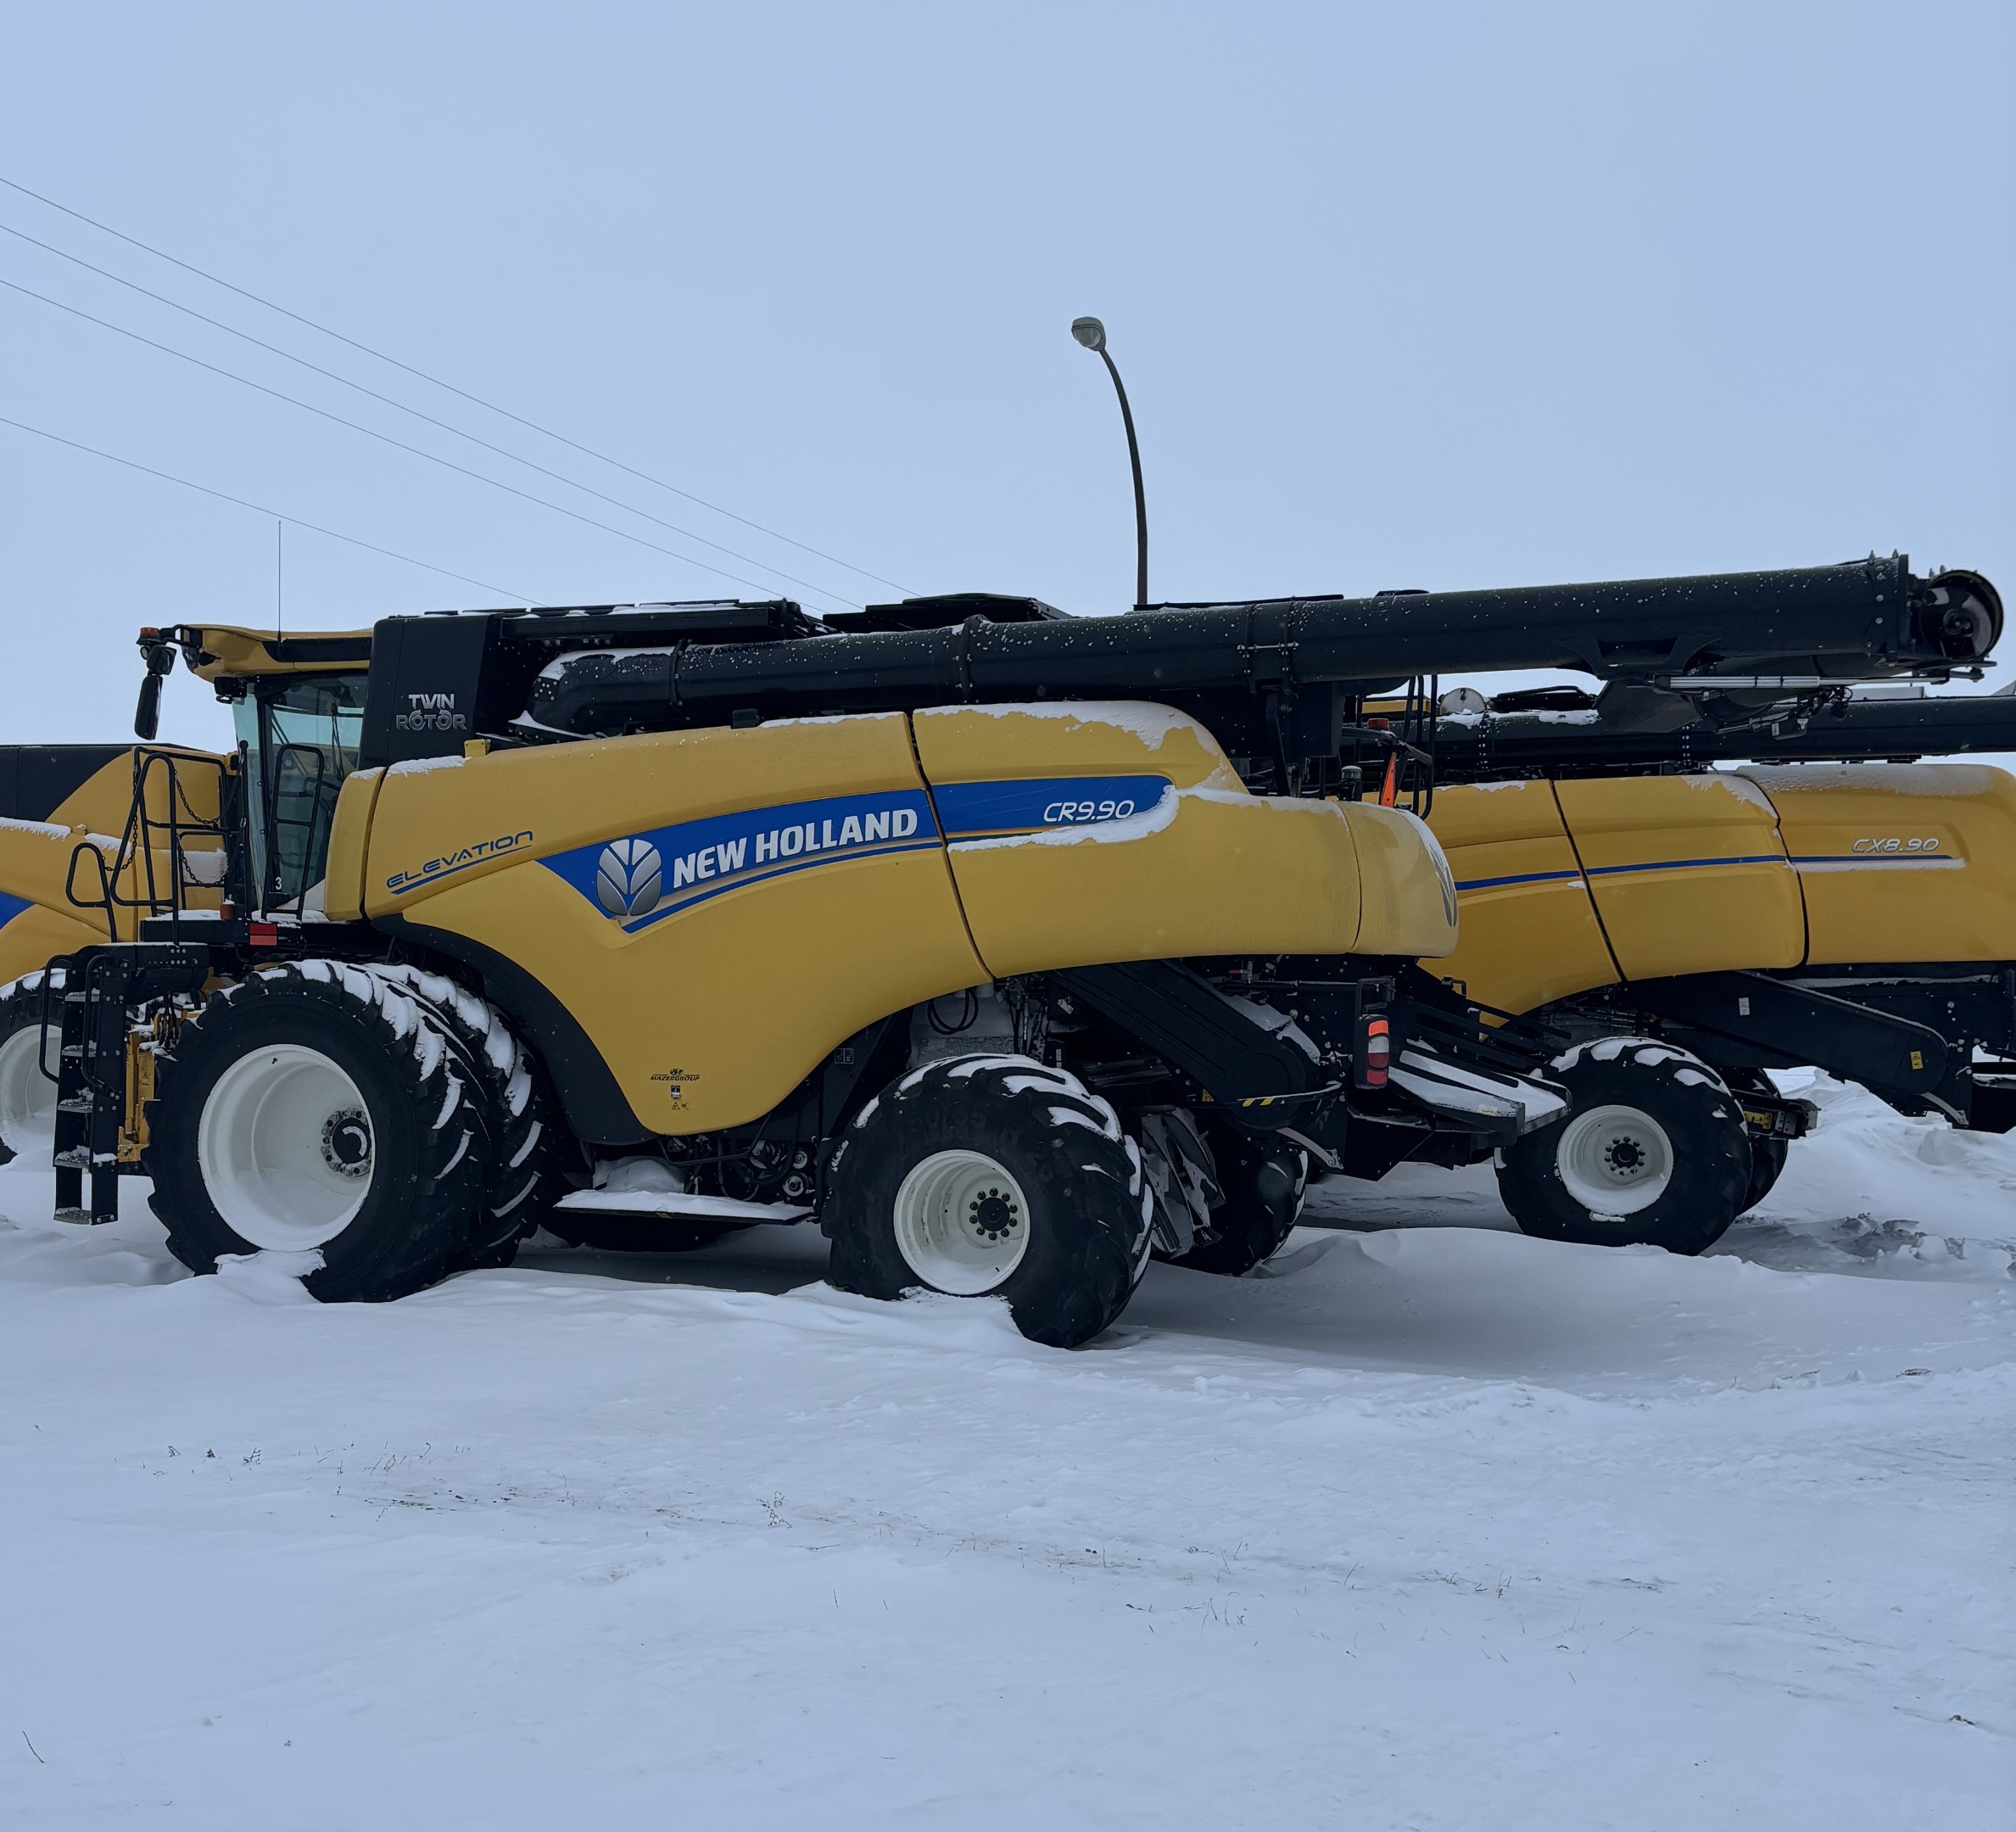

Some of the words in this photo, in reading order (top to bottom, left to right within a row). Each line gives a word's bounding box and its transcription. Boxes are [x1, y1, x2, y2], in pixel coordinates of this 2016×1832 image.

[408, 693, 455, 709] TWIN
[396, 709, 467, 730] ROTOR
[1042, 799, 1135, 823] CR9.90
[673, 845, 747, 889] NEW
[755, 808, 918, 863] HOLLAND
[1851, 837, 1940, 853] CX8.90
[275, 876, 282, 891] 3
